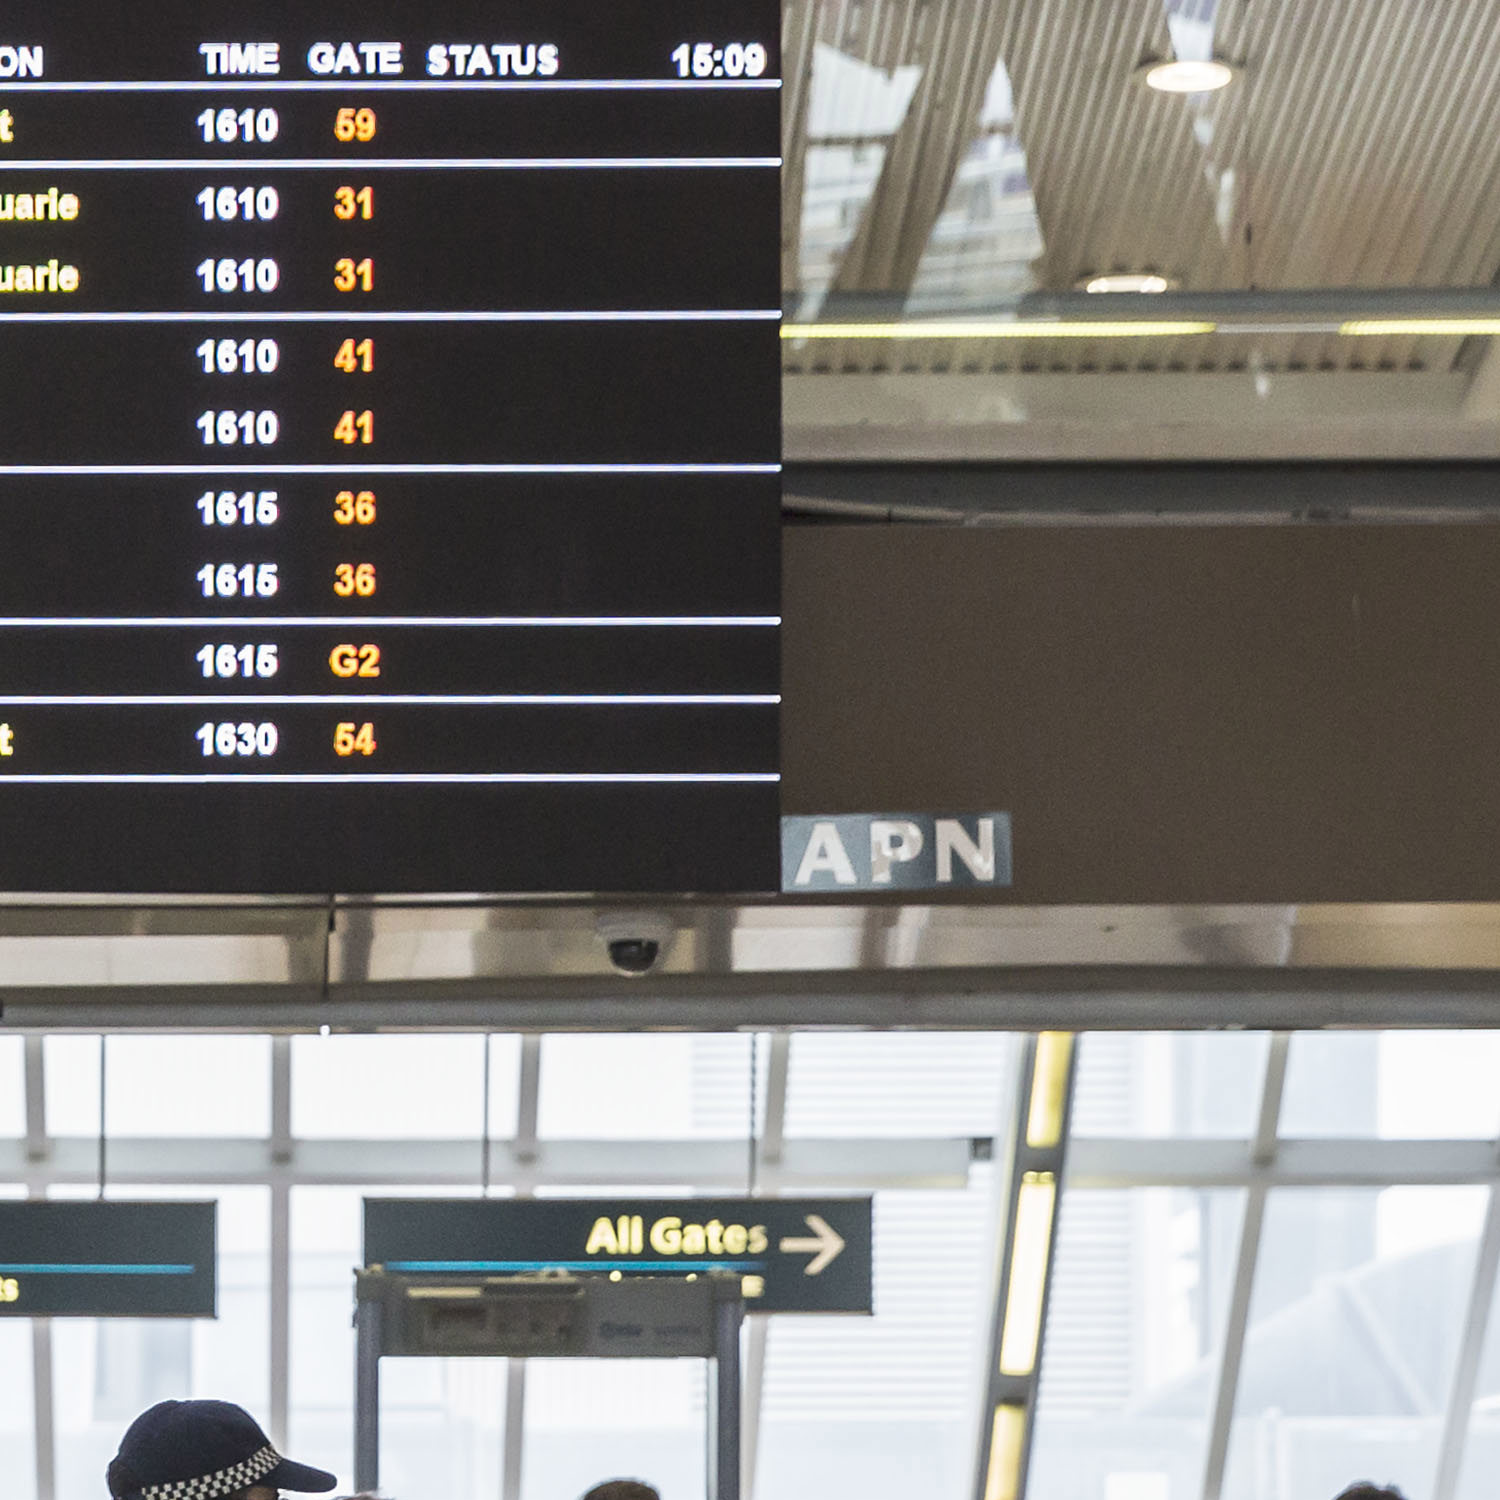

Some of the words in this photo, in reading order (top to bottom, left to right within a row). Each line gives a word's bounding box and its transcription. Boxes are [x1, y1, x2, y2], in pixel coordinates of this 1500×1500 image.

[196, 186, 279, 221] 1610
[334, 186, 373, 220] 31
[196, 339, 279, 373] 1610
[334, 339, 373, 372] 41
[196, 491, 279, 526] 1615
[334, 491, 376, 524] 36
[195, 723, 278, 756] 1630
[334, 723, 376, 756] 54
[793, 818, 997, 886] APN
[586, 1216, 643, 1254] All
[650, 1217, 767, 1254] Gates
